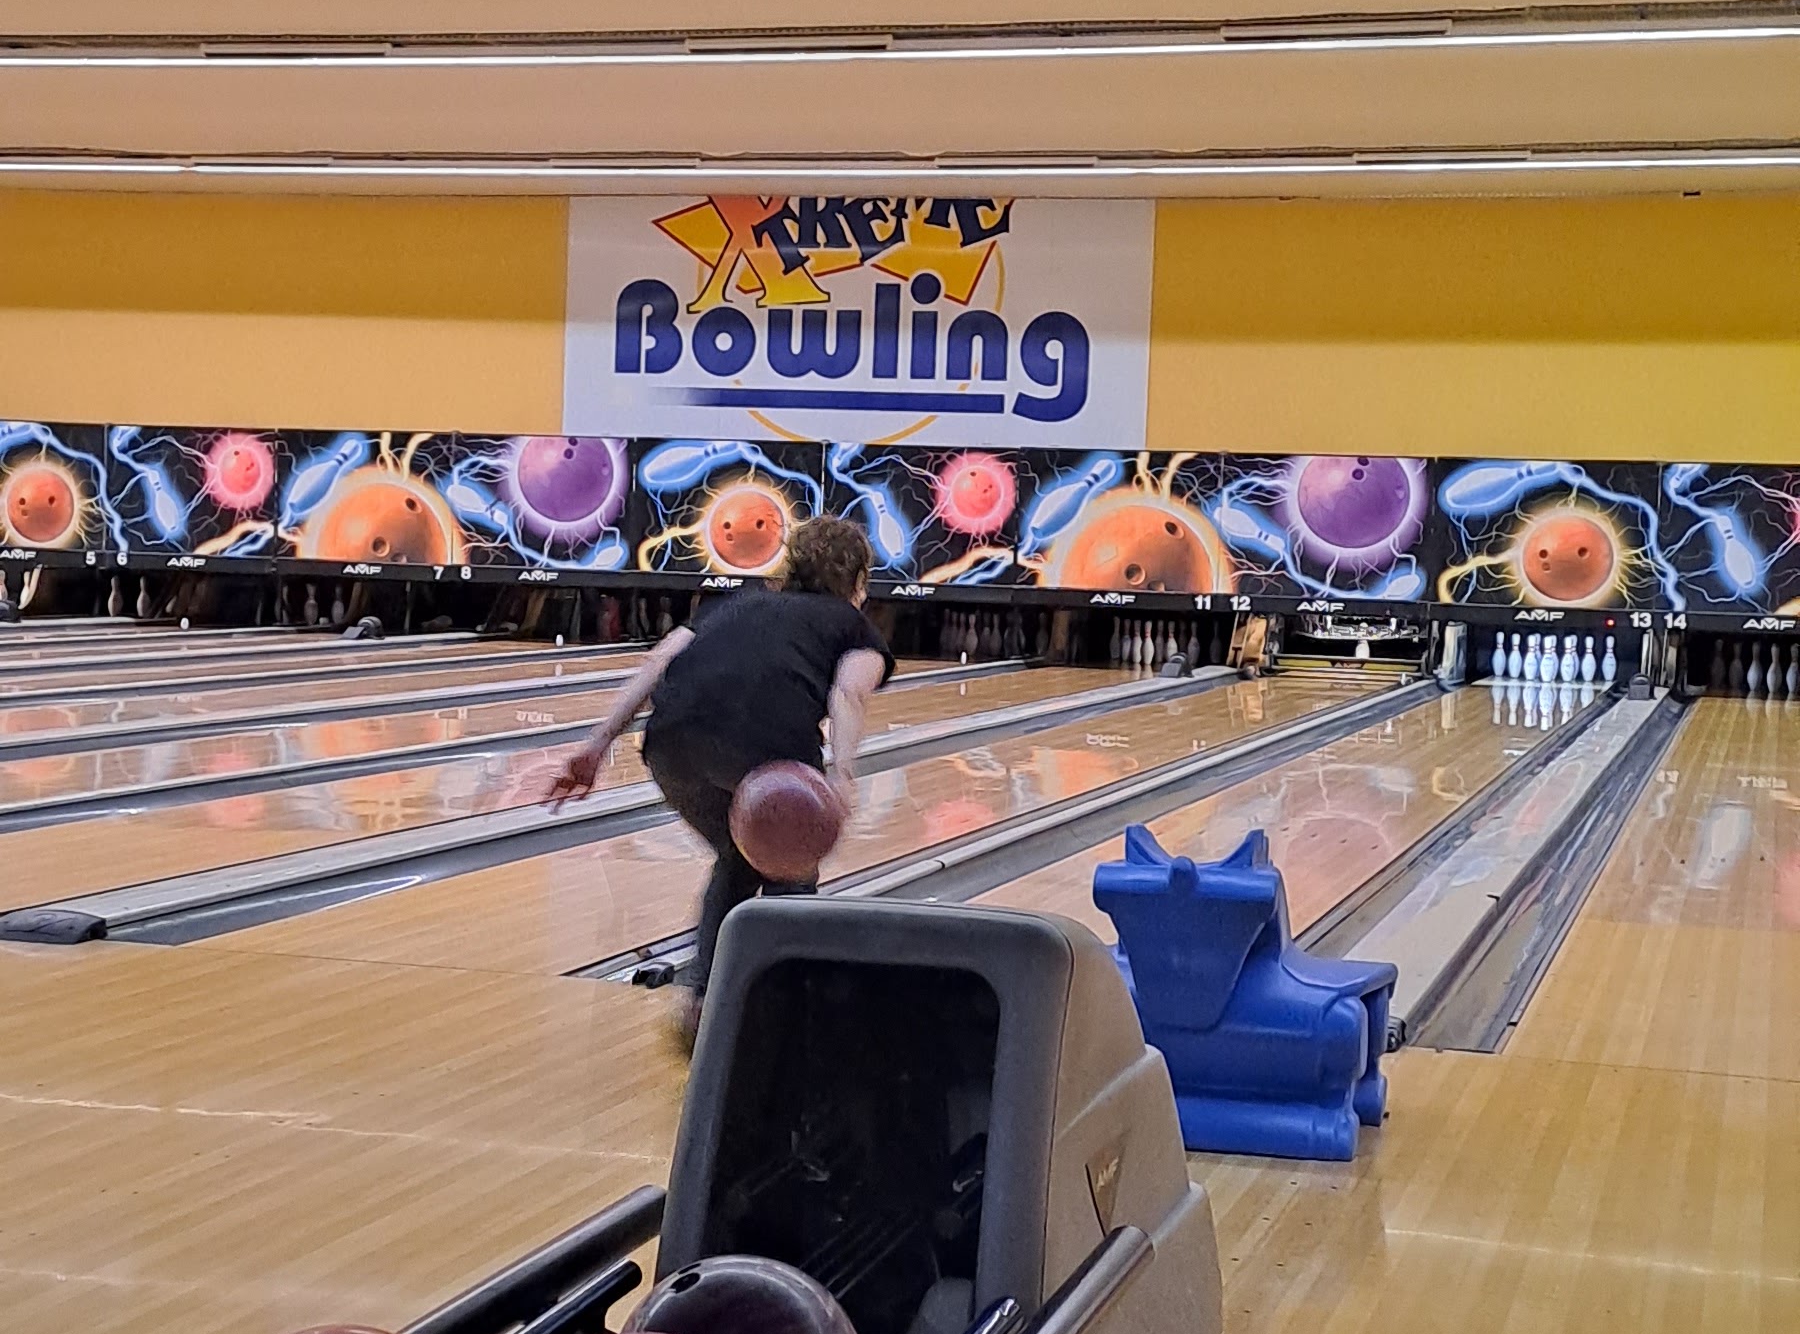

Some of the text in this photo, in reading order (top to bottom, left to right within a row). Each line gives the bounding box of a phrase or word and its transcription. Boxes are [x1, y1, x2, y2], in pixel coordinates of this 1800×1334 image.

[614, 272, 1090, 423] Bowling
[0, 548, 37, 560] AMF
[85, 551, 96, 565] 5
[116, 552, 128, 565] 6
[167, 556, 207, 568] AMF
[342, 563, 382, 575] AMF
[433, 566, 444, 579] 7
[460, 566, 472, 580] 8
[518, 569, 559, 582] AMF
[701, 576, 744, 588] AMF
[890, 585, 936, 596] AMF
[1090, 592, 1136, 605] AMF
[1194, 595, 1212, 610] 11
[1229, 595, 1251, 611] 12
[1296, 600, 1346, 612] AMF
[1514, 609, 1565, 622] AMF
[1630, 612, 1652, 628] 13
[1664, 613, 1687, 629] 14
[1742, 617, 1796, 631] AMF
